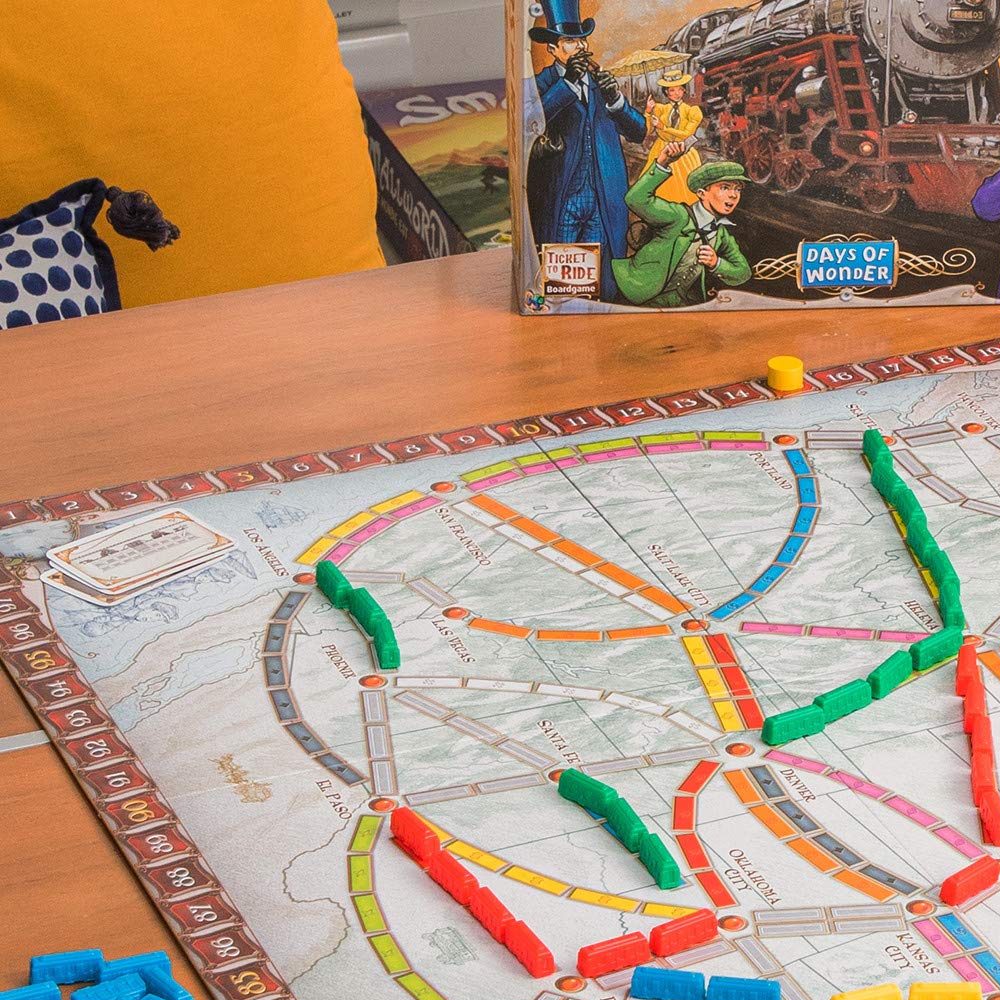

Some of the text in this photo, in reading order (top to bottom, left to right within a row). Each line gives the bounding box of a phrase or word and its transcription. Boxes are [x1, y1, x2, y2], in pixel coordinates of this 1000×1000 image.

[394, 90, 507, 128] Sm
[547, 252, 586, 264] TICKET
[806, 246, 890, 264] DAYS OF
[547, 264, 596, 280] TO RIDE
[546, 284, 596, 294] Boardgame
[878, 363, 900, 374] 17
[927, 354, 954, 366] 18
[826, 372, 853, 382] 16
[672, 398, 698, 408] 13
[724, 390, 749, 400] 14
[566, 416, 588, 426] 11
[617, 406, 645, 418] 12
[458, 435, 476, 444] 9
[507, 424, 540, 437] 10
[350, 453, 361, 462] 7
[403, 444, 420, 454] 8
[292, 462, 310, 472] 6
[750, 452, 793, 490] PORTLAND
[239, 471, 254, 482] 5
[120, 490, 138, 500] 3
[180, 482, 194, 490] 4
[64, 501, 79, 510] 2
[8, 510, 16, 520] 1
[434, 507, 491, 566] SAN FRANCISCO
[243, 528, 290, 577] LOS ANGELES
[648, 544, 712, 606] SALT LAKE CITY
[904, 600, 940, 630] HELENA
[9, 623, 34, 640] 96
[432, 619, 476, 664] LAS VEGAS
[24, 650, 56, 670] 95
[322, 644, 357, 679] PHOENIX
[46, 680, 72, 698] 94
[66, 709, 92, 727] 93
[84, 738, 111, 758] 92
[536, 719, 582, 764] SANTA FE
[105, 772, 130, 788] 91
[780, 768, 816, 804] DENVER
[316, 779, 353, 820] EL PASO
[122, 799, 154, 822] 90
[146, 834, 173, 854] 89
[166, 867, 196, 888] 88
[724, 868, 752, 892] CITY
[728, 848, 782, 904] OKLAHOMA
[189, 904, 218, 922] 87
[211, 936, 240, 958] 86
[896, 932, 940, 975] KANSAS
[884, 944, 915, 970] CITY
[230, 971, 267, 996] 85
